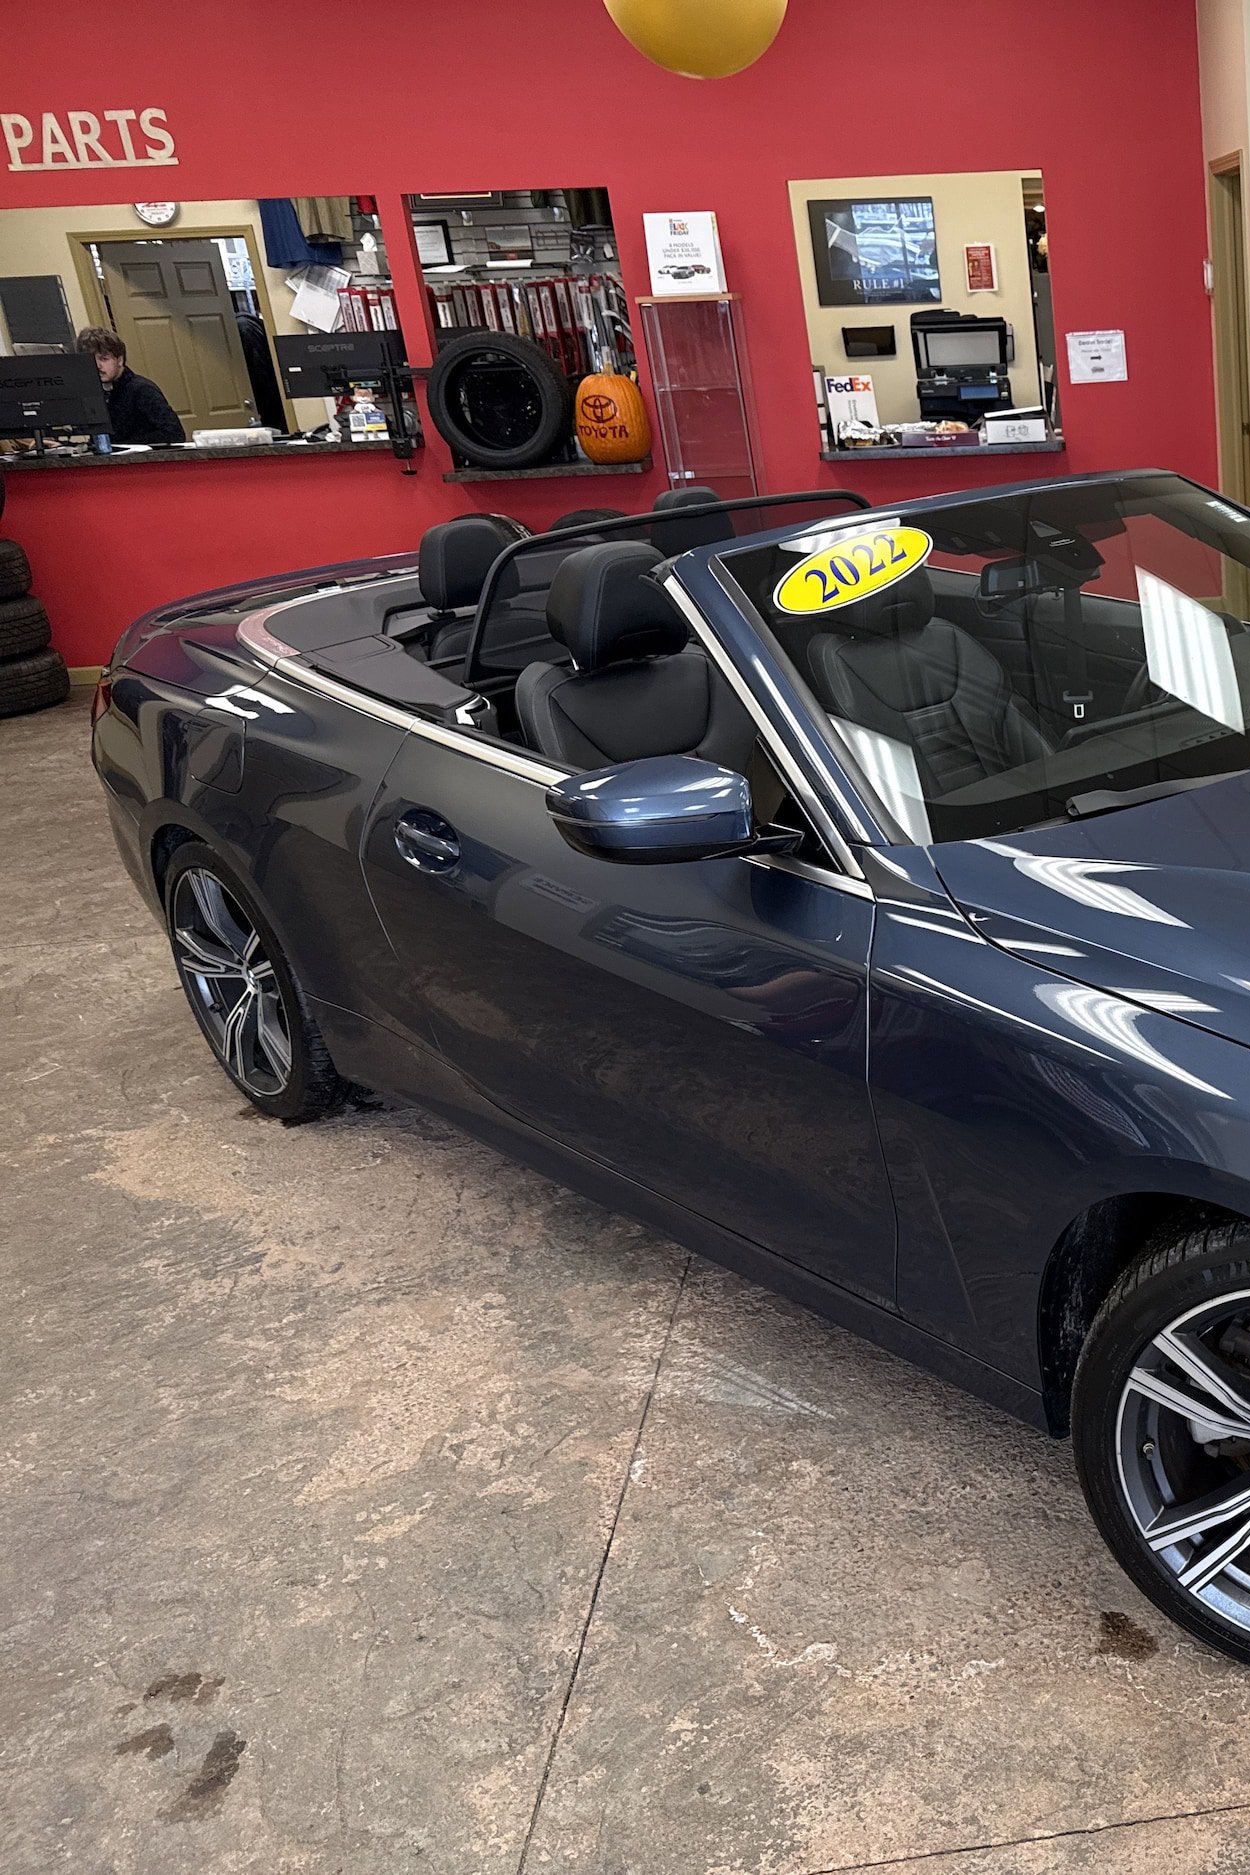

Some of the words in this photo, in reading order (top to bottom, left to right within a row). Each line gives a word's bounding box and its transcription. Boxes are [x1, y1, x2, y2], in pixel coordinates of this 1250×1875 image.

[0, 107, 175, 167] PARTS
[853, 278, 891, 290] RULE
[893, 277, 905, 289] #1
[307, 343, 355, 353] SCEPTRE
[826, 377, 872, 394] FedEx
[579, 425, 629, 439] TOYOTA
[805, 534, 907, 604] 2022
